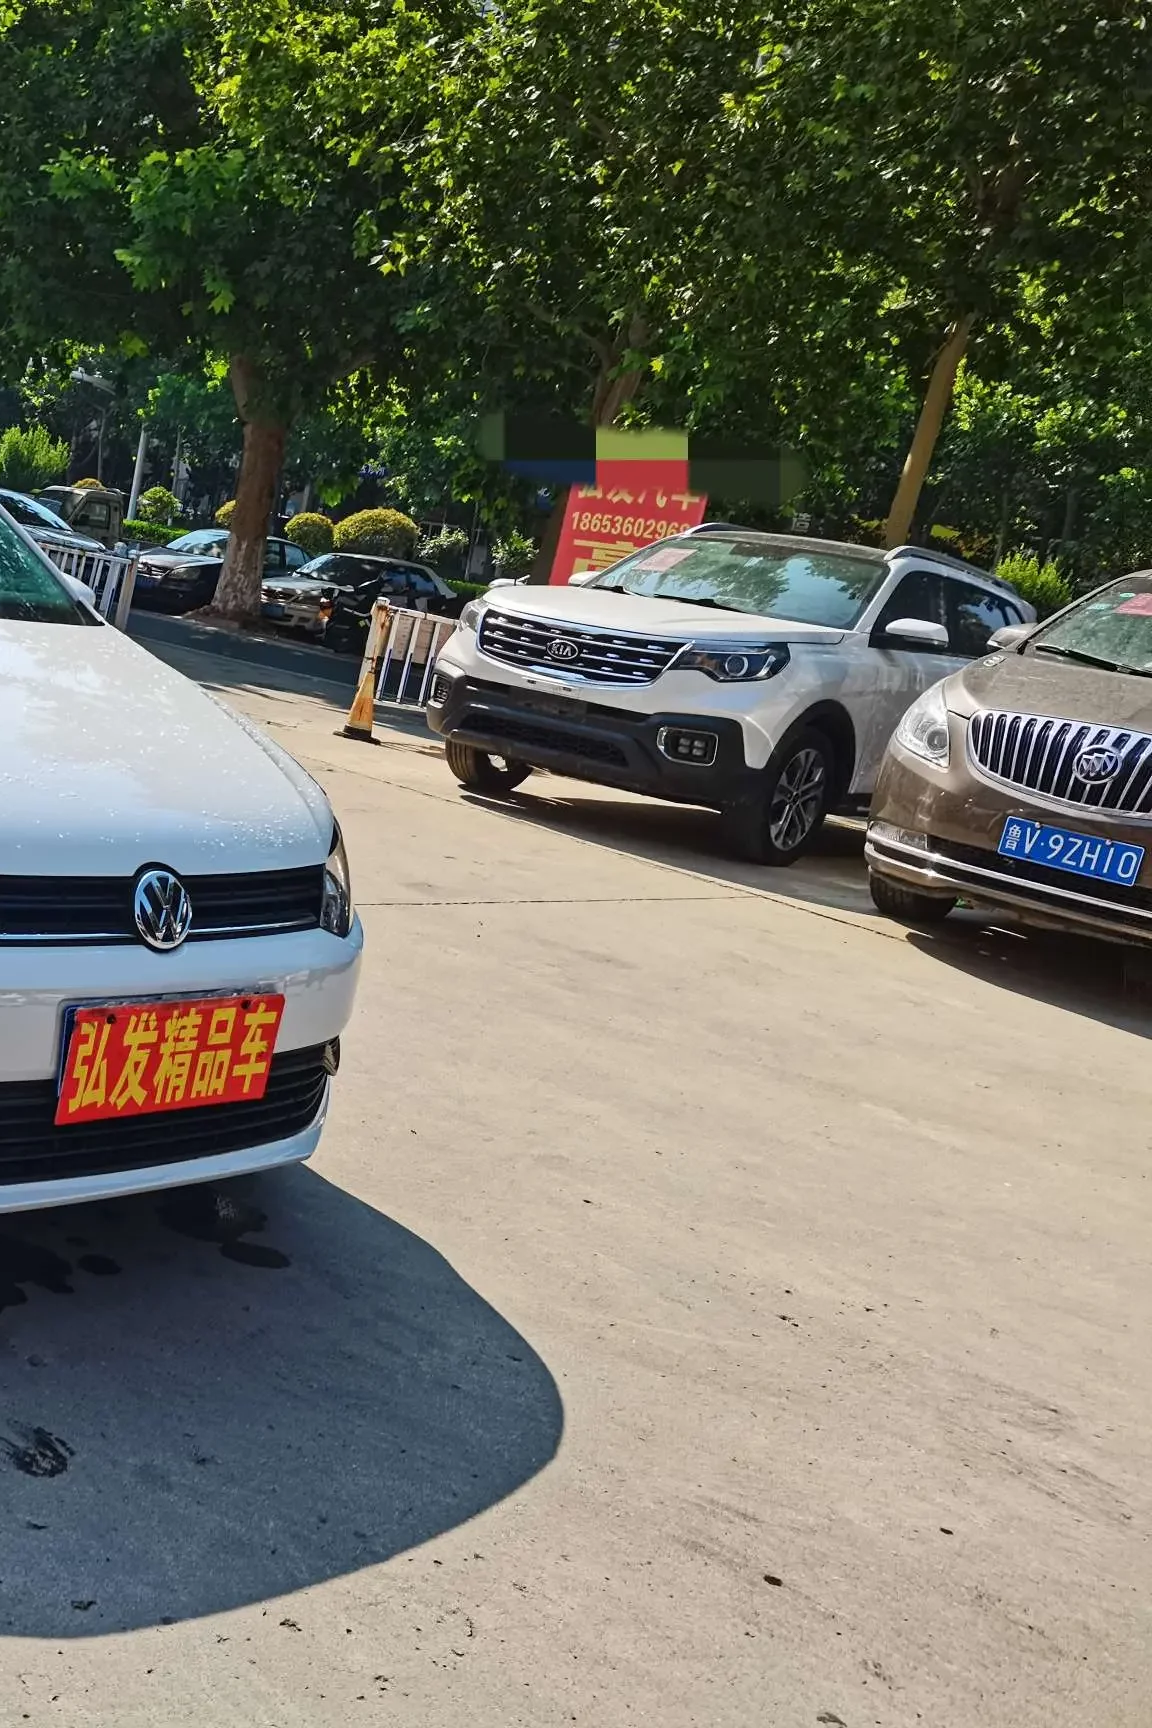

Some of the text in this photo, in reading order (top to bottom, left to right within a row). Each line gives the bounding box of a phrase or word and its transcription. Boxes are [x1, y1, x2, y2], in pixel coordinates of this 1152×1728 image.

[550, 643, 572, 657] KIA
[68, 1002, 278, 1114] 弘发精品车
